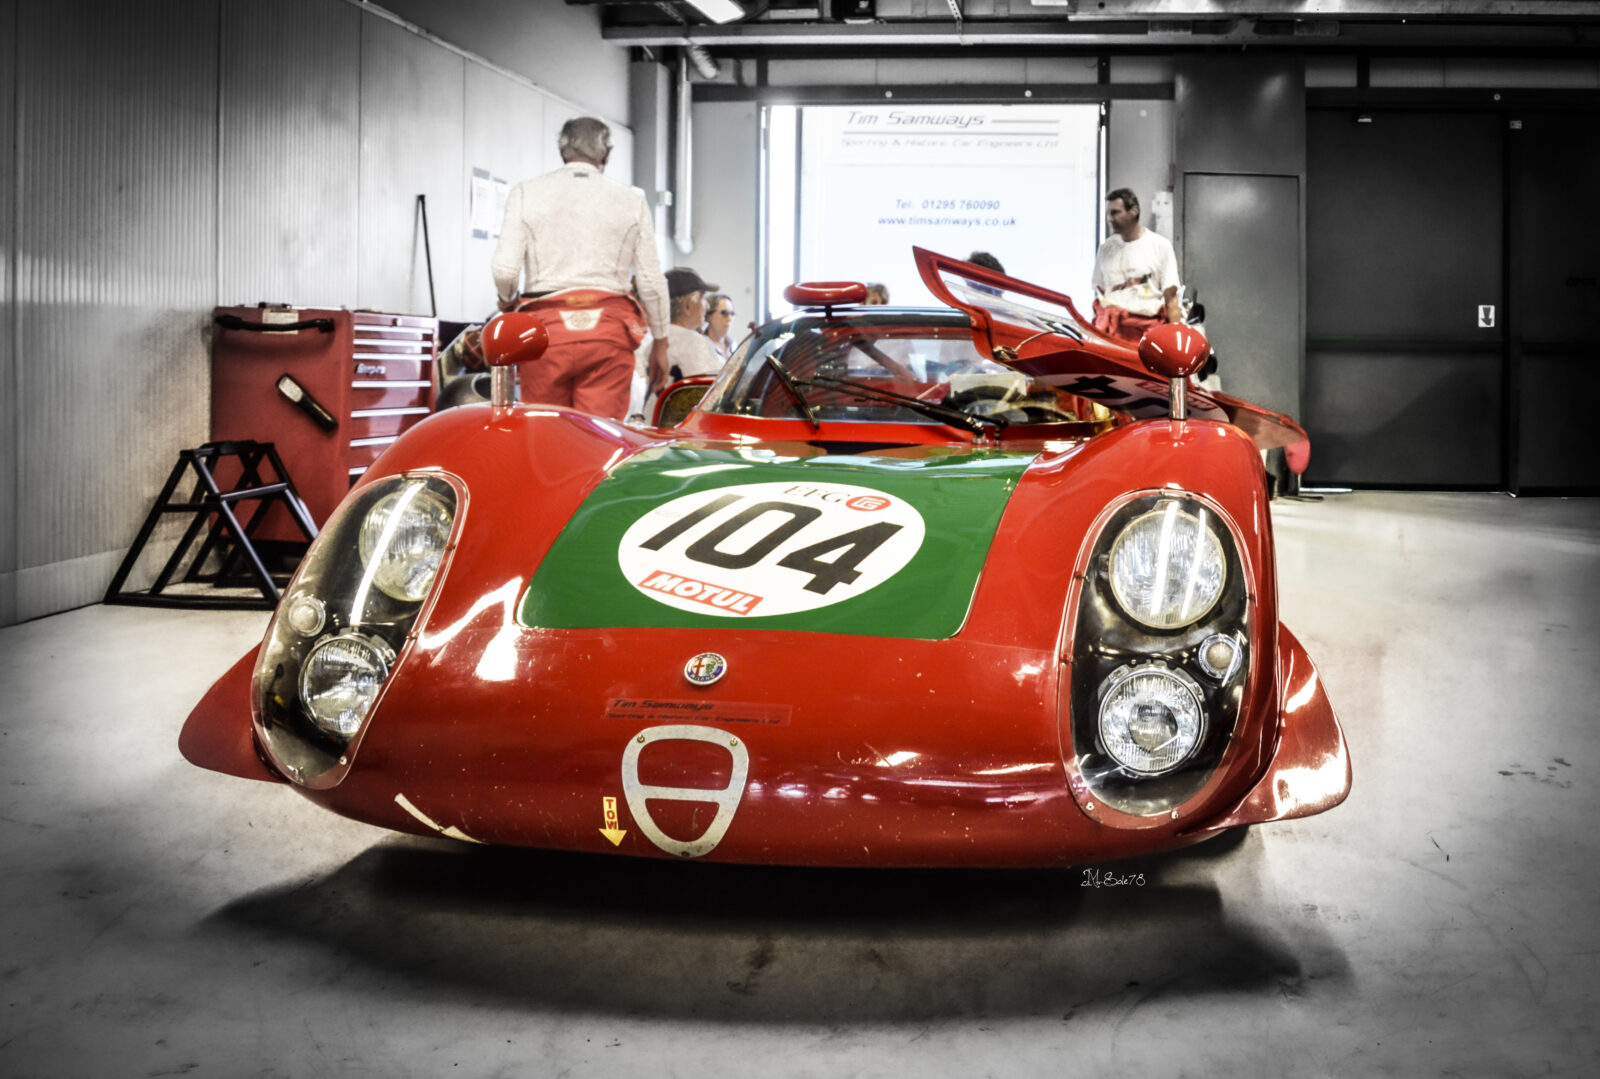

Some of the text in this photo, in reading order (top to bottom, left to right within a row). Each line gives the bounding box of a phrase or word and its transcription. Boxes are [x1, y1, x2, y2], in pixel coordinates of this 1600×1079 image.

[847, 111, 985, 128] Tim Samways
[952, 139, 971, 147] Car
[921, 200, 956, 210] 01295
[959, 200, 1001, 210] 760090
[877, 215, 1017, 227] www.timsamways.co.uk
[784, 485, 850, 503] EFG
[638, 493, 905, 596] 104
[642, 573, 757, 612] MOTUL
[605, 799, 617, 830] TOW
